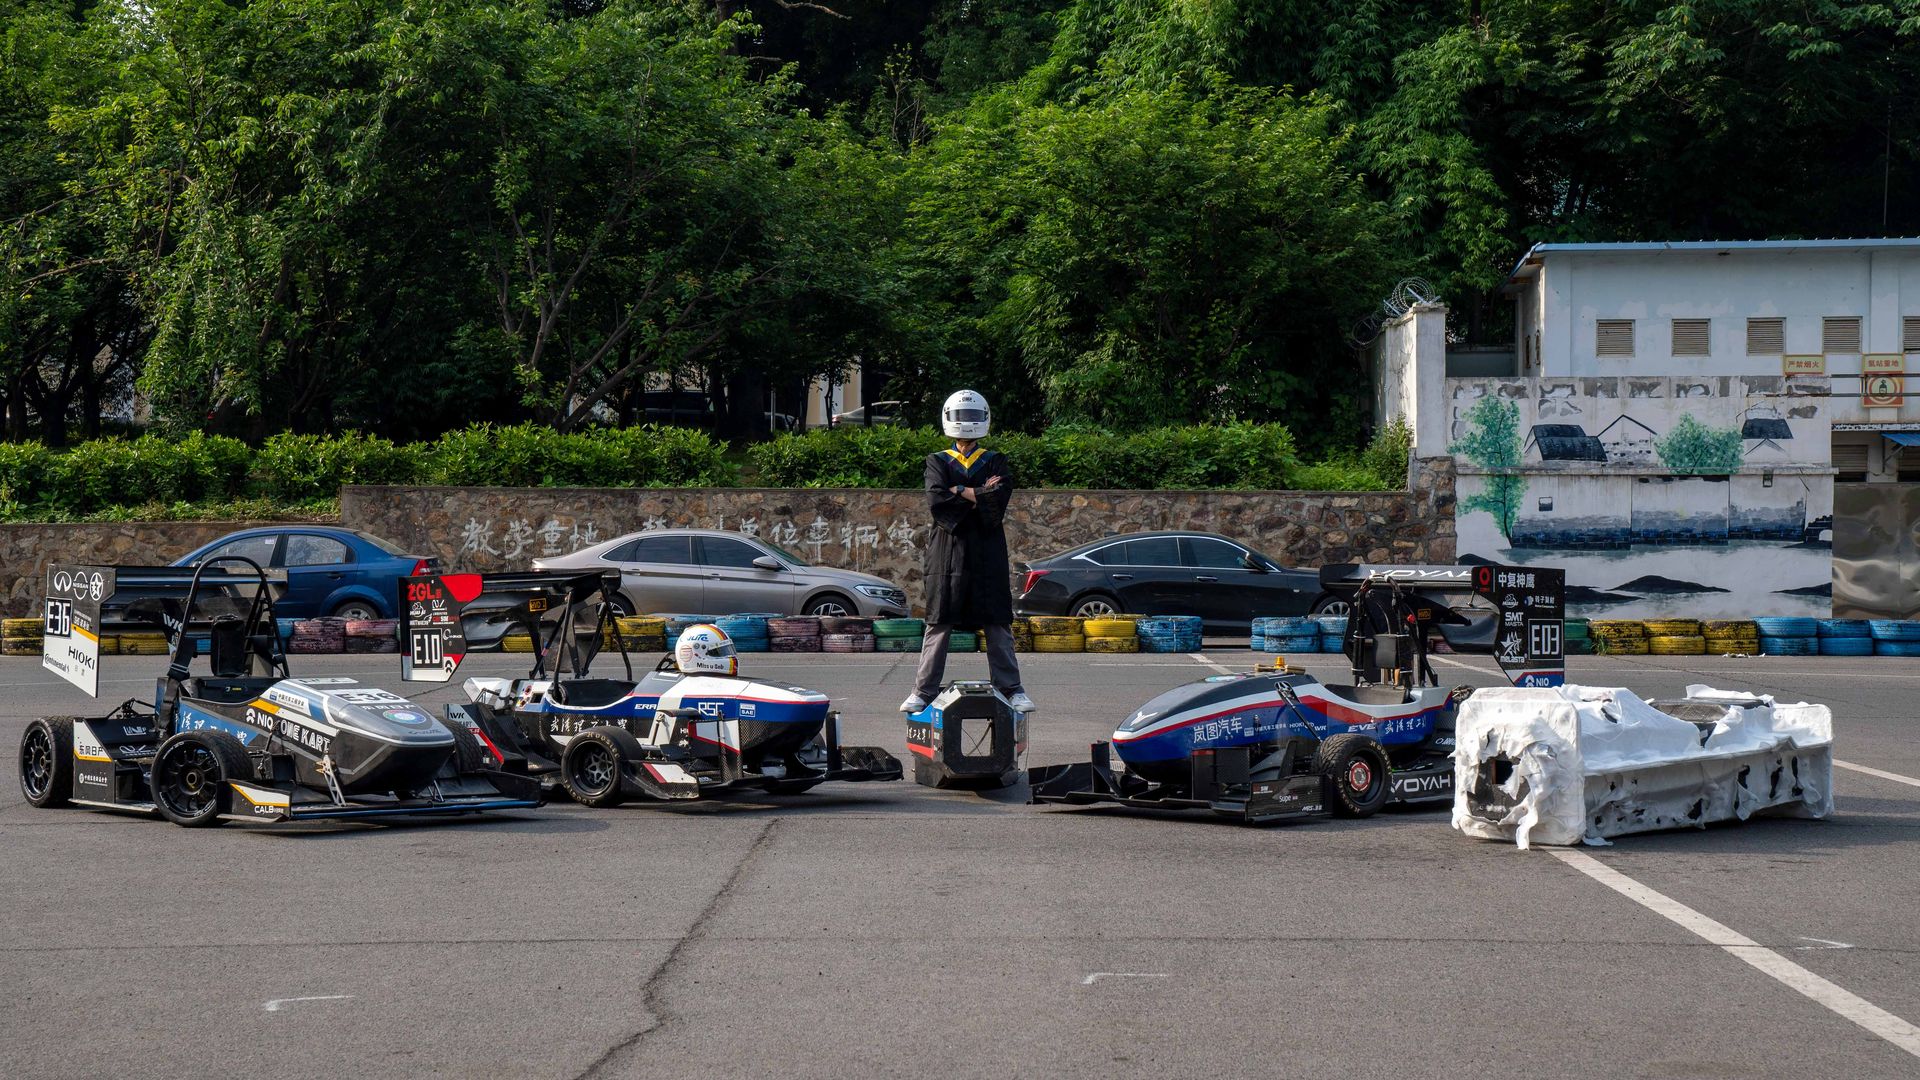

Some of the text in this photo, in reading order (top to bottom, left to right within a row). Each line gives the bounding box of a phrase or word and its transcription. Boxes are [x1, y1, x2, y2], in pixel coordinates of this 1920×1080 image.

[1498, 572, 1535, 589] 中复神鹰
[47, 601, 70, 636] E36
[1505, 612, 1523, 621] SMT
[413, 634, 440, 664] E10
[1531, 625, 1560, 655] E03
[68, 645, 95, 670] HIOKI
[1536, 678, 1549, 686] NIO
[257, 712, 274, 730] NIO
[1193, 716, 1243, 744] 岚图汽车
[1347, 722, 1374, 733] EVE
[1392, 774, 1452, 793] VOYAH
[254, 805, 274, 814] CALB
